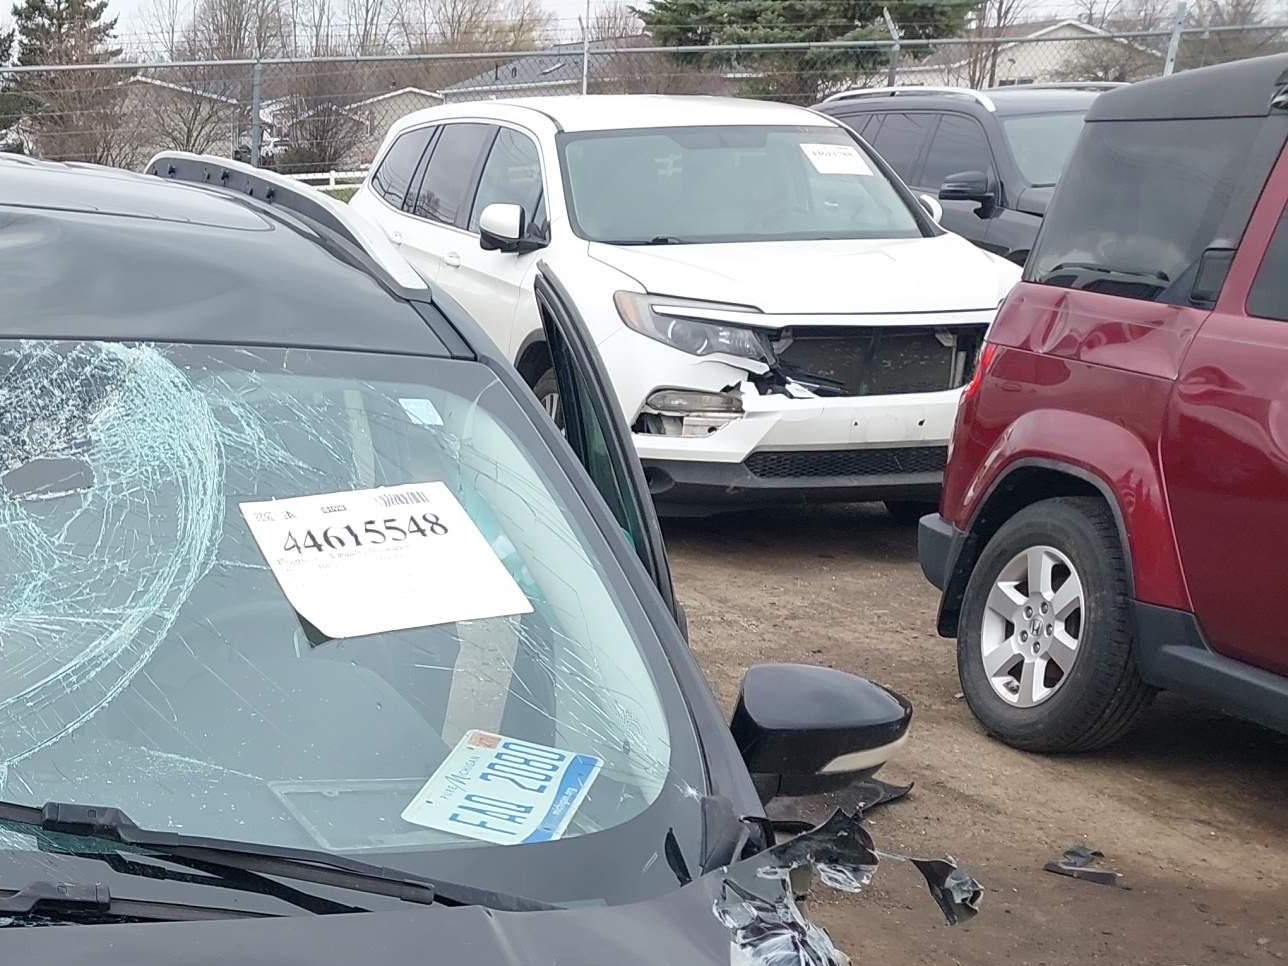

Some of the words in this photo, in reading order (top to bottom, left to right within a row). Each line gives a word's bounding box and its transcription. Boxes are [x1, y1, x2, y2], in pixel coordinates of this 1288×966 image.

[283, 512, 449, 555] 44615548
[478, 741, 567, 794] 2080
[448, 793, 536, 836] FAQ
